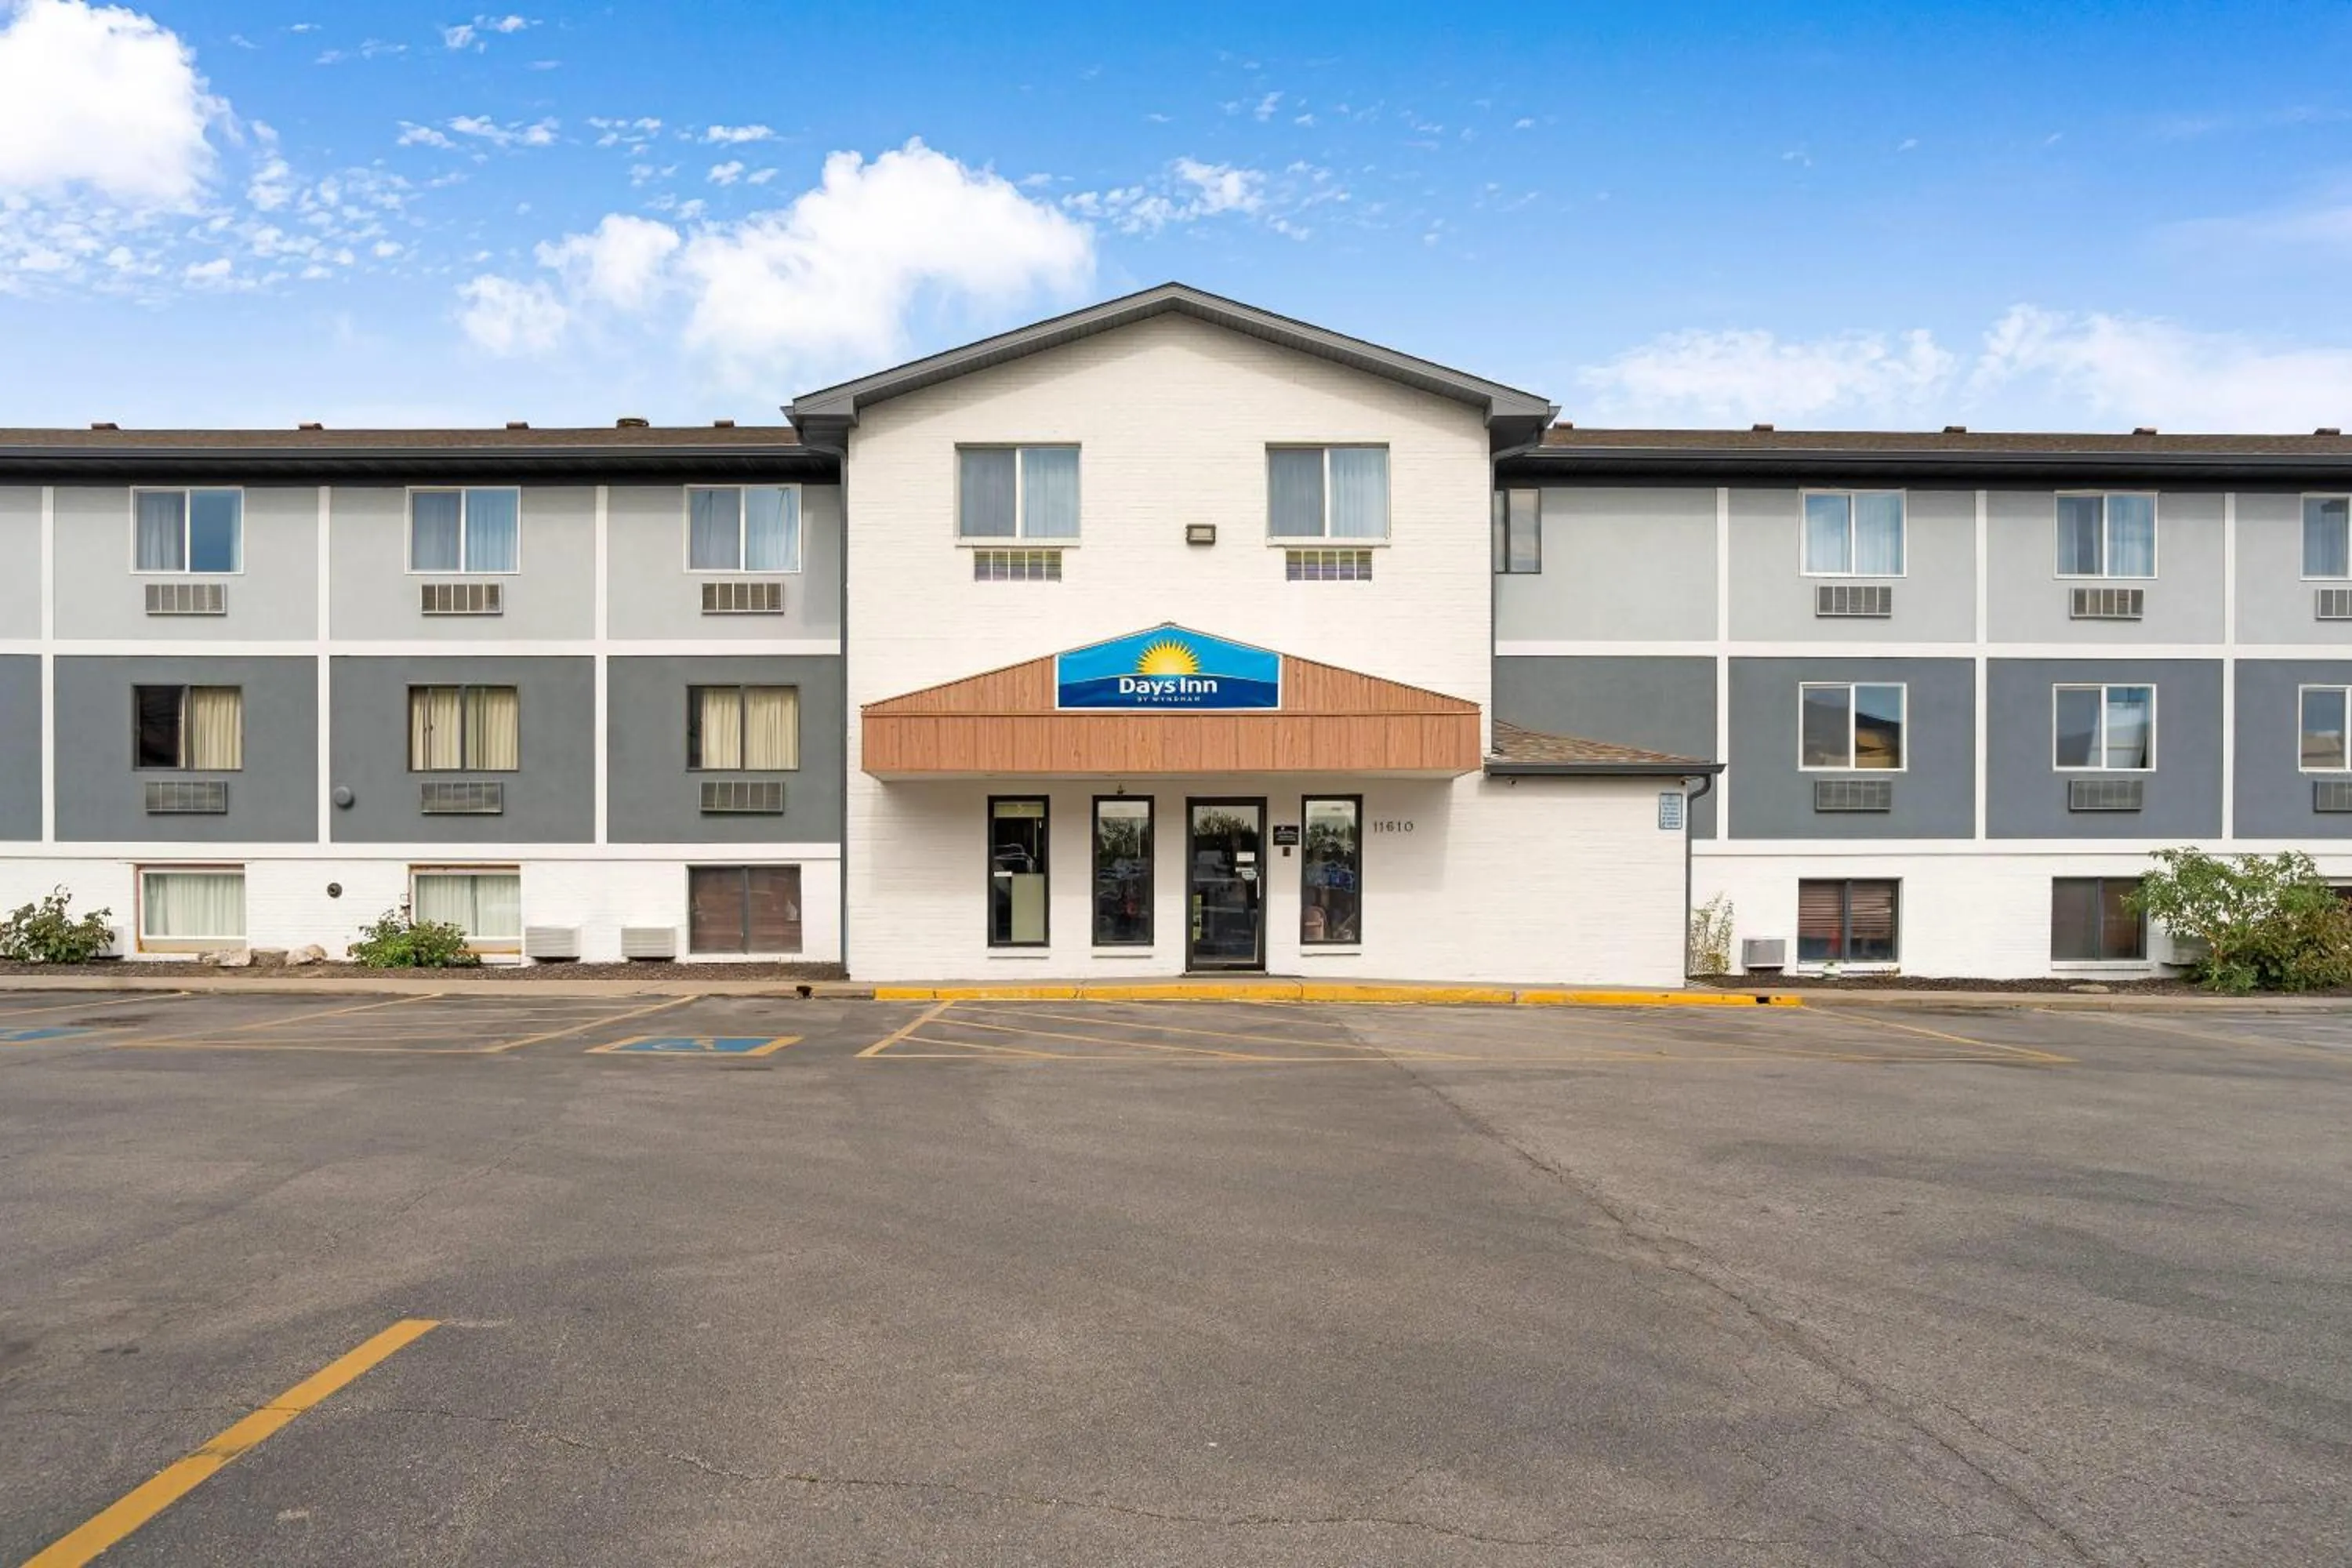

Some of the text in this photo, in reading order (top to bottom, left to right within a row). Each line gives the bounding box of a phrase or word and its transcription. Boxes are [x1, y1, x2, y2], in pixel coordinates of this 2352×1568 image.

[1119, 677, 1218, 696] Days Inn
[1374, 820, 1414, 833] 11610
